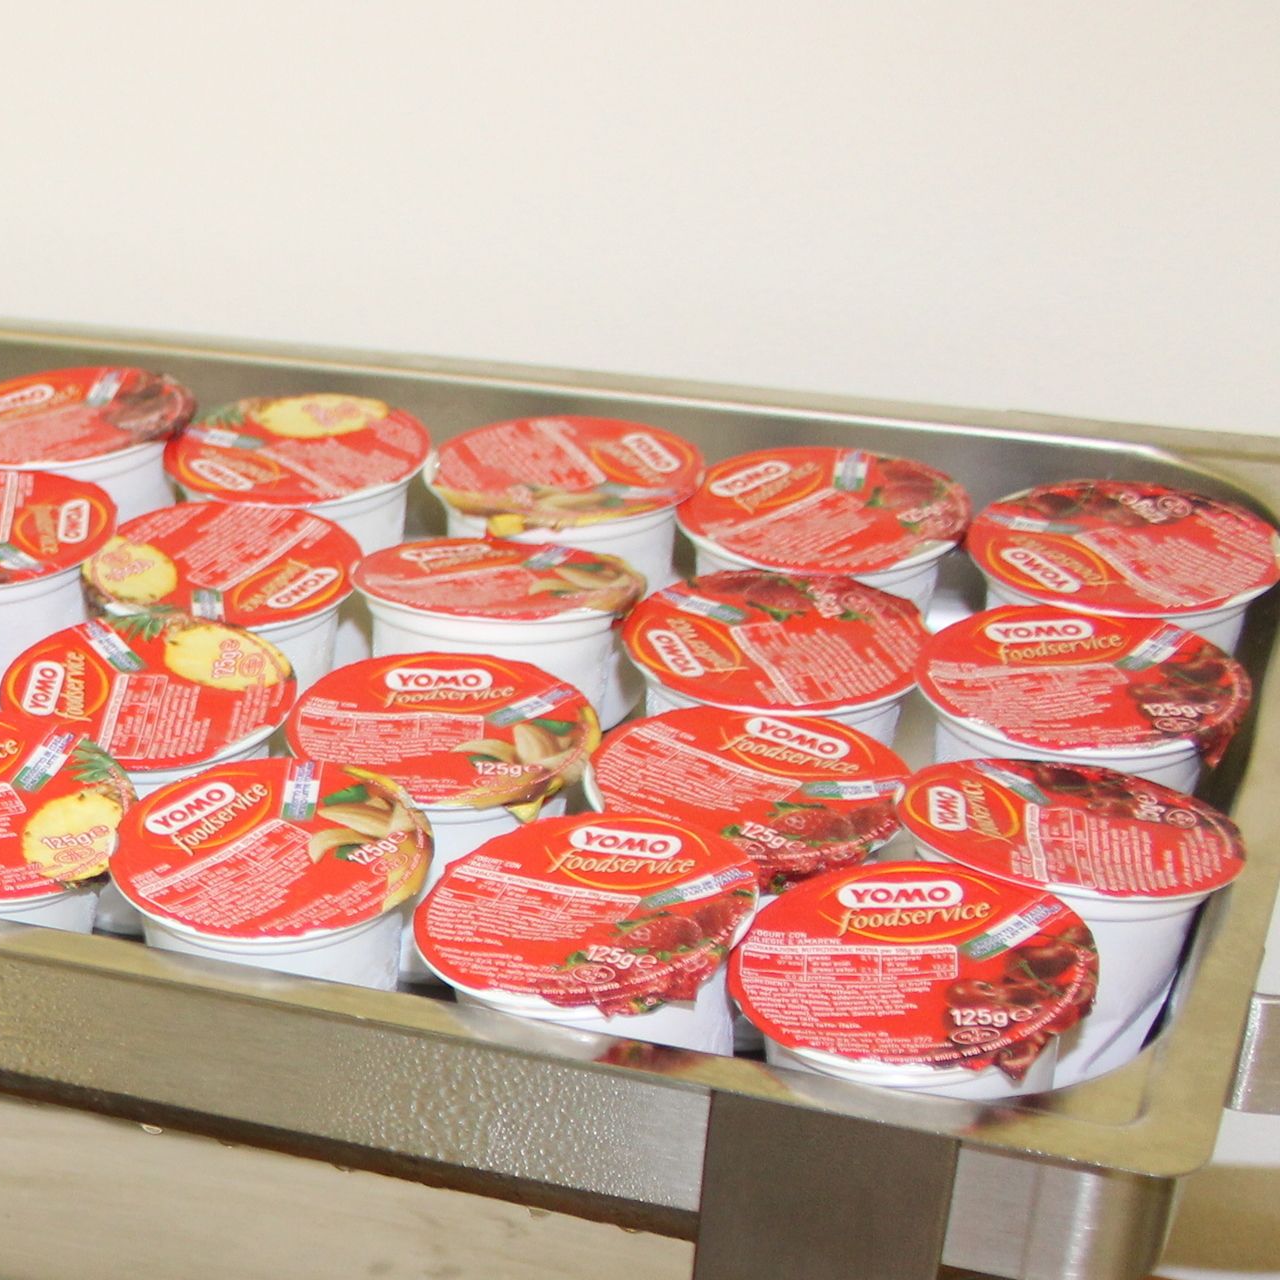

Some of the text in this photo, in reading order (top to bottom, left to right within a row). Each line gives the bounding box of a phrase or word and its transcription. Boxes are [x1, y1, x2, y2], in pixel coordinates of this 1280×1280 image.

[1011, 550, 1072, 590] YOMO
[273, 570, 333, 606] YOMO
[993, 623, 1082, 640] YOMO
[997, 631, 1124, 664] foodservice
[654, 633, 697, 674] YOMO
[27, 667, 59, 711] YOMO
[53, 651, 93, 723] foodservice
[382, 685, 516, 709] foodservice
[396, 673, 484, 689] YOMO
[720, 735, 860, 775] foodservice
[758, 721, 840, 755] YOMO
[152, 786, 227, 830] YOMO
[170, 781, 269, 857] foodservice
[937, 791, 955, 828] YOMO
[580, 830, 672, 855] YOMO
[549, 849, 697, 875] foodservice
[850, 886, 951, 904] YOMO
[837, 902, 992, 937] foodservice
